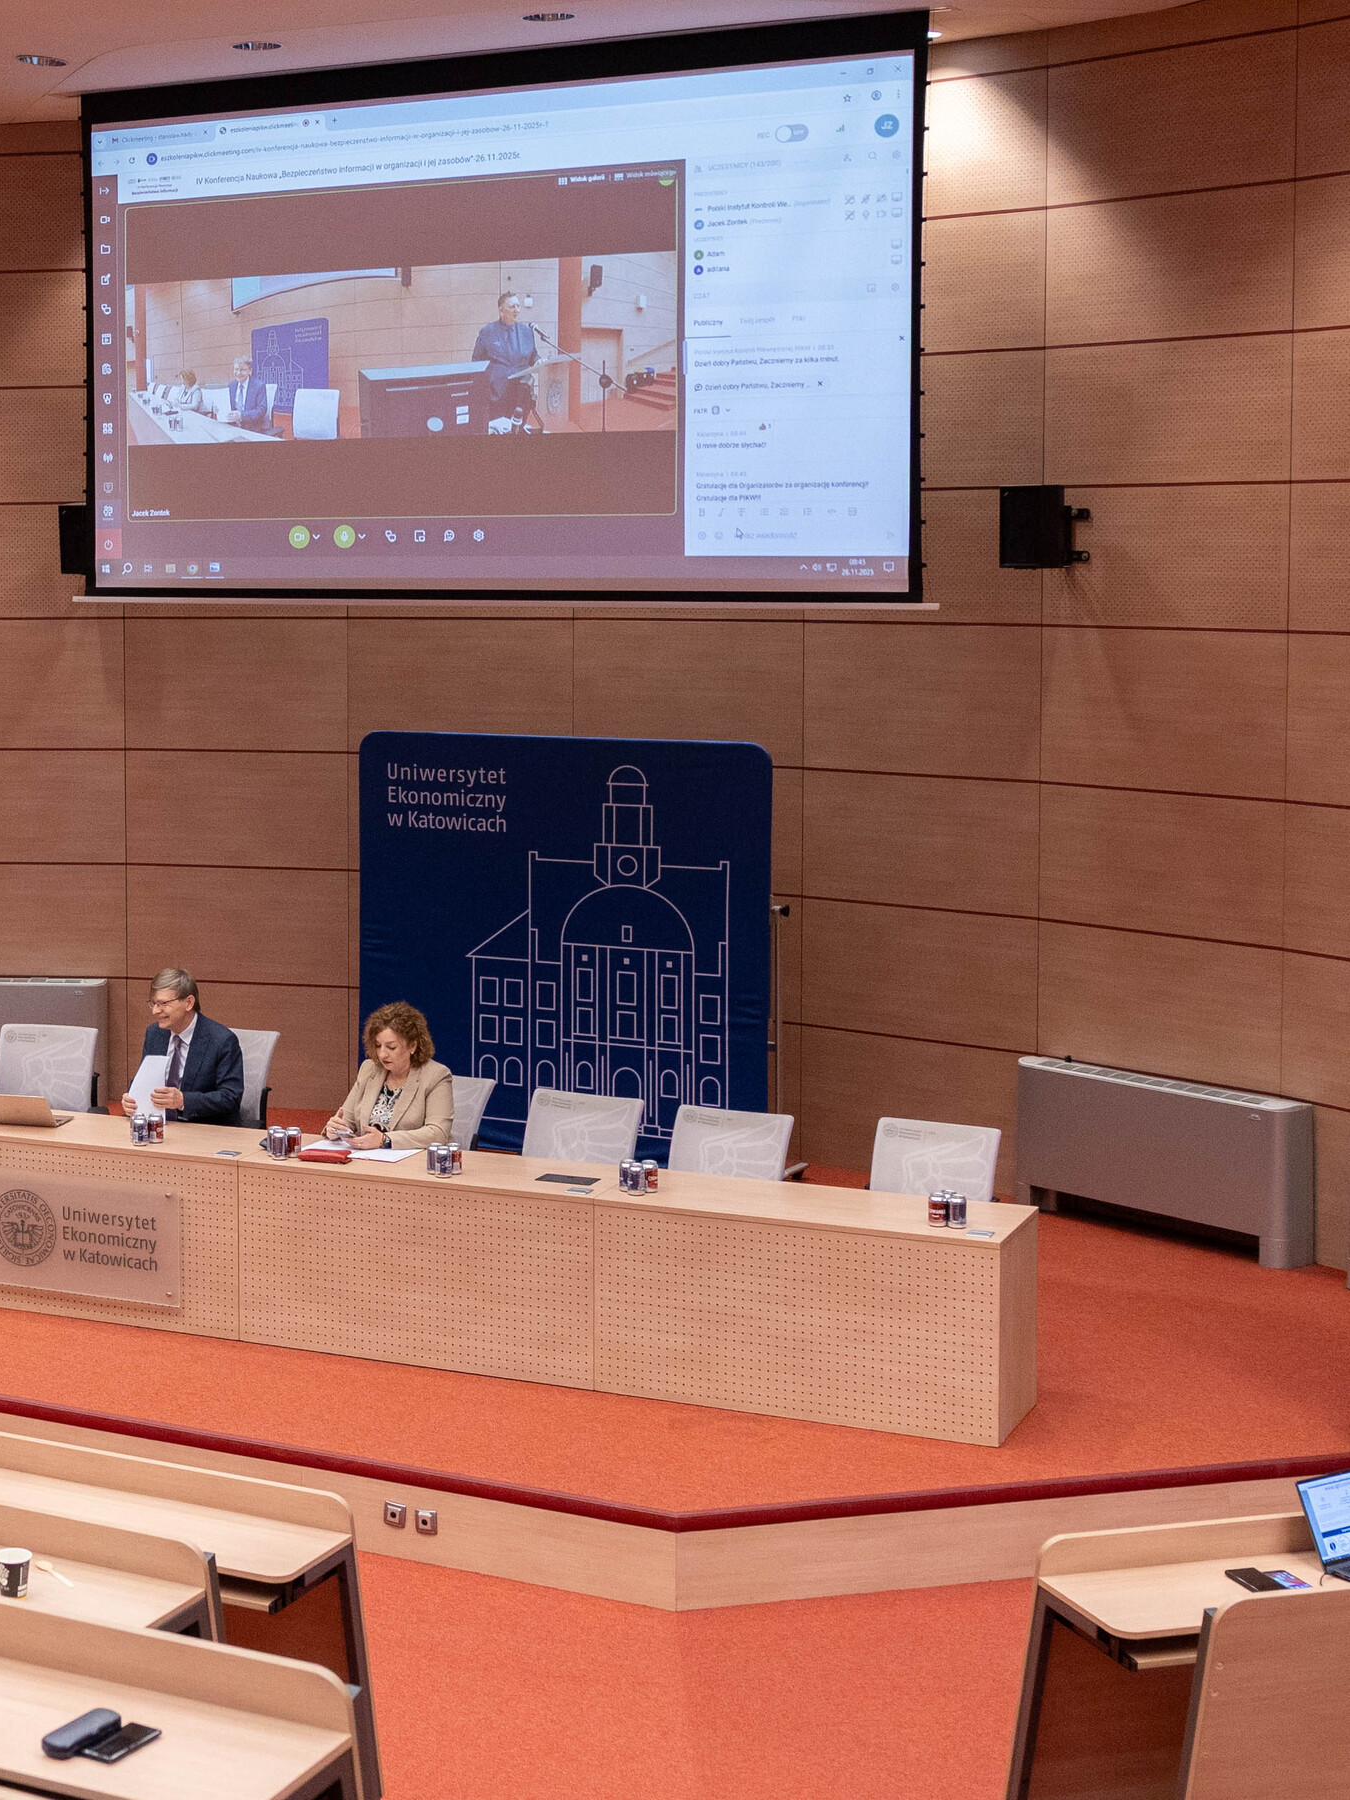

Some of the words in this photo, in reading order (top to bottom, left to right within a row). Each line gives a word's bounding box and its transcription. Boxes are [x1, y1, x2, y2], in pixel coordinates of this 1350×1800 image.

[881, 121, 893, 130] JZ
[196, 177, 204, 185] IV
[204, 174, 244, 185] Konferencja
[246, 171, 278, 181] Naukowa
[339, 163, 374, 174] informacji
[383, 158, 423, 171] organizacji
[427, 158, 437, 168] jej
[570, 175, 587, 183] Widok
[707, 219, 726, 227] Jacek
[693, 319, 723, 327] Publiczny
[694, 359, 712, 367] Dzień
[712, 359, 730, 368] dobry
[718, 441, 740, 449] dobrze
[728, 481, 738, 489] dla
[387, 762, 507, 787] Uniwersytet
[387, 786, 507, 812] Ekonomiczny
[387, 813, 403, 827] w
[408, 810, 507, 833] Katowicach
[62, 1206, 157, 1231] Uniwersytet
[62, 1226, 157, 1254] Ekonomiczny
[63, 1250, 75, 1262] w
[79, 1249, 158, 1272] Katowicach
